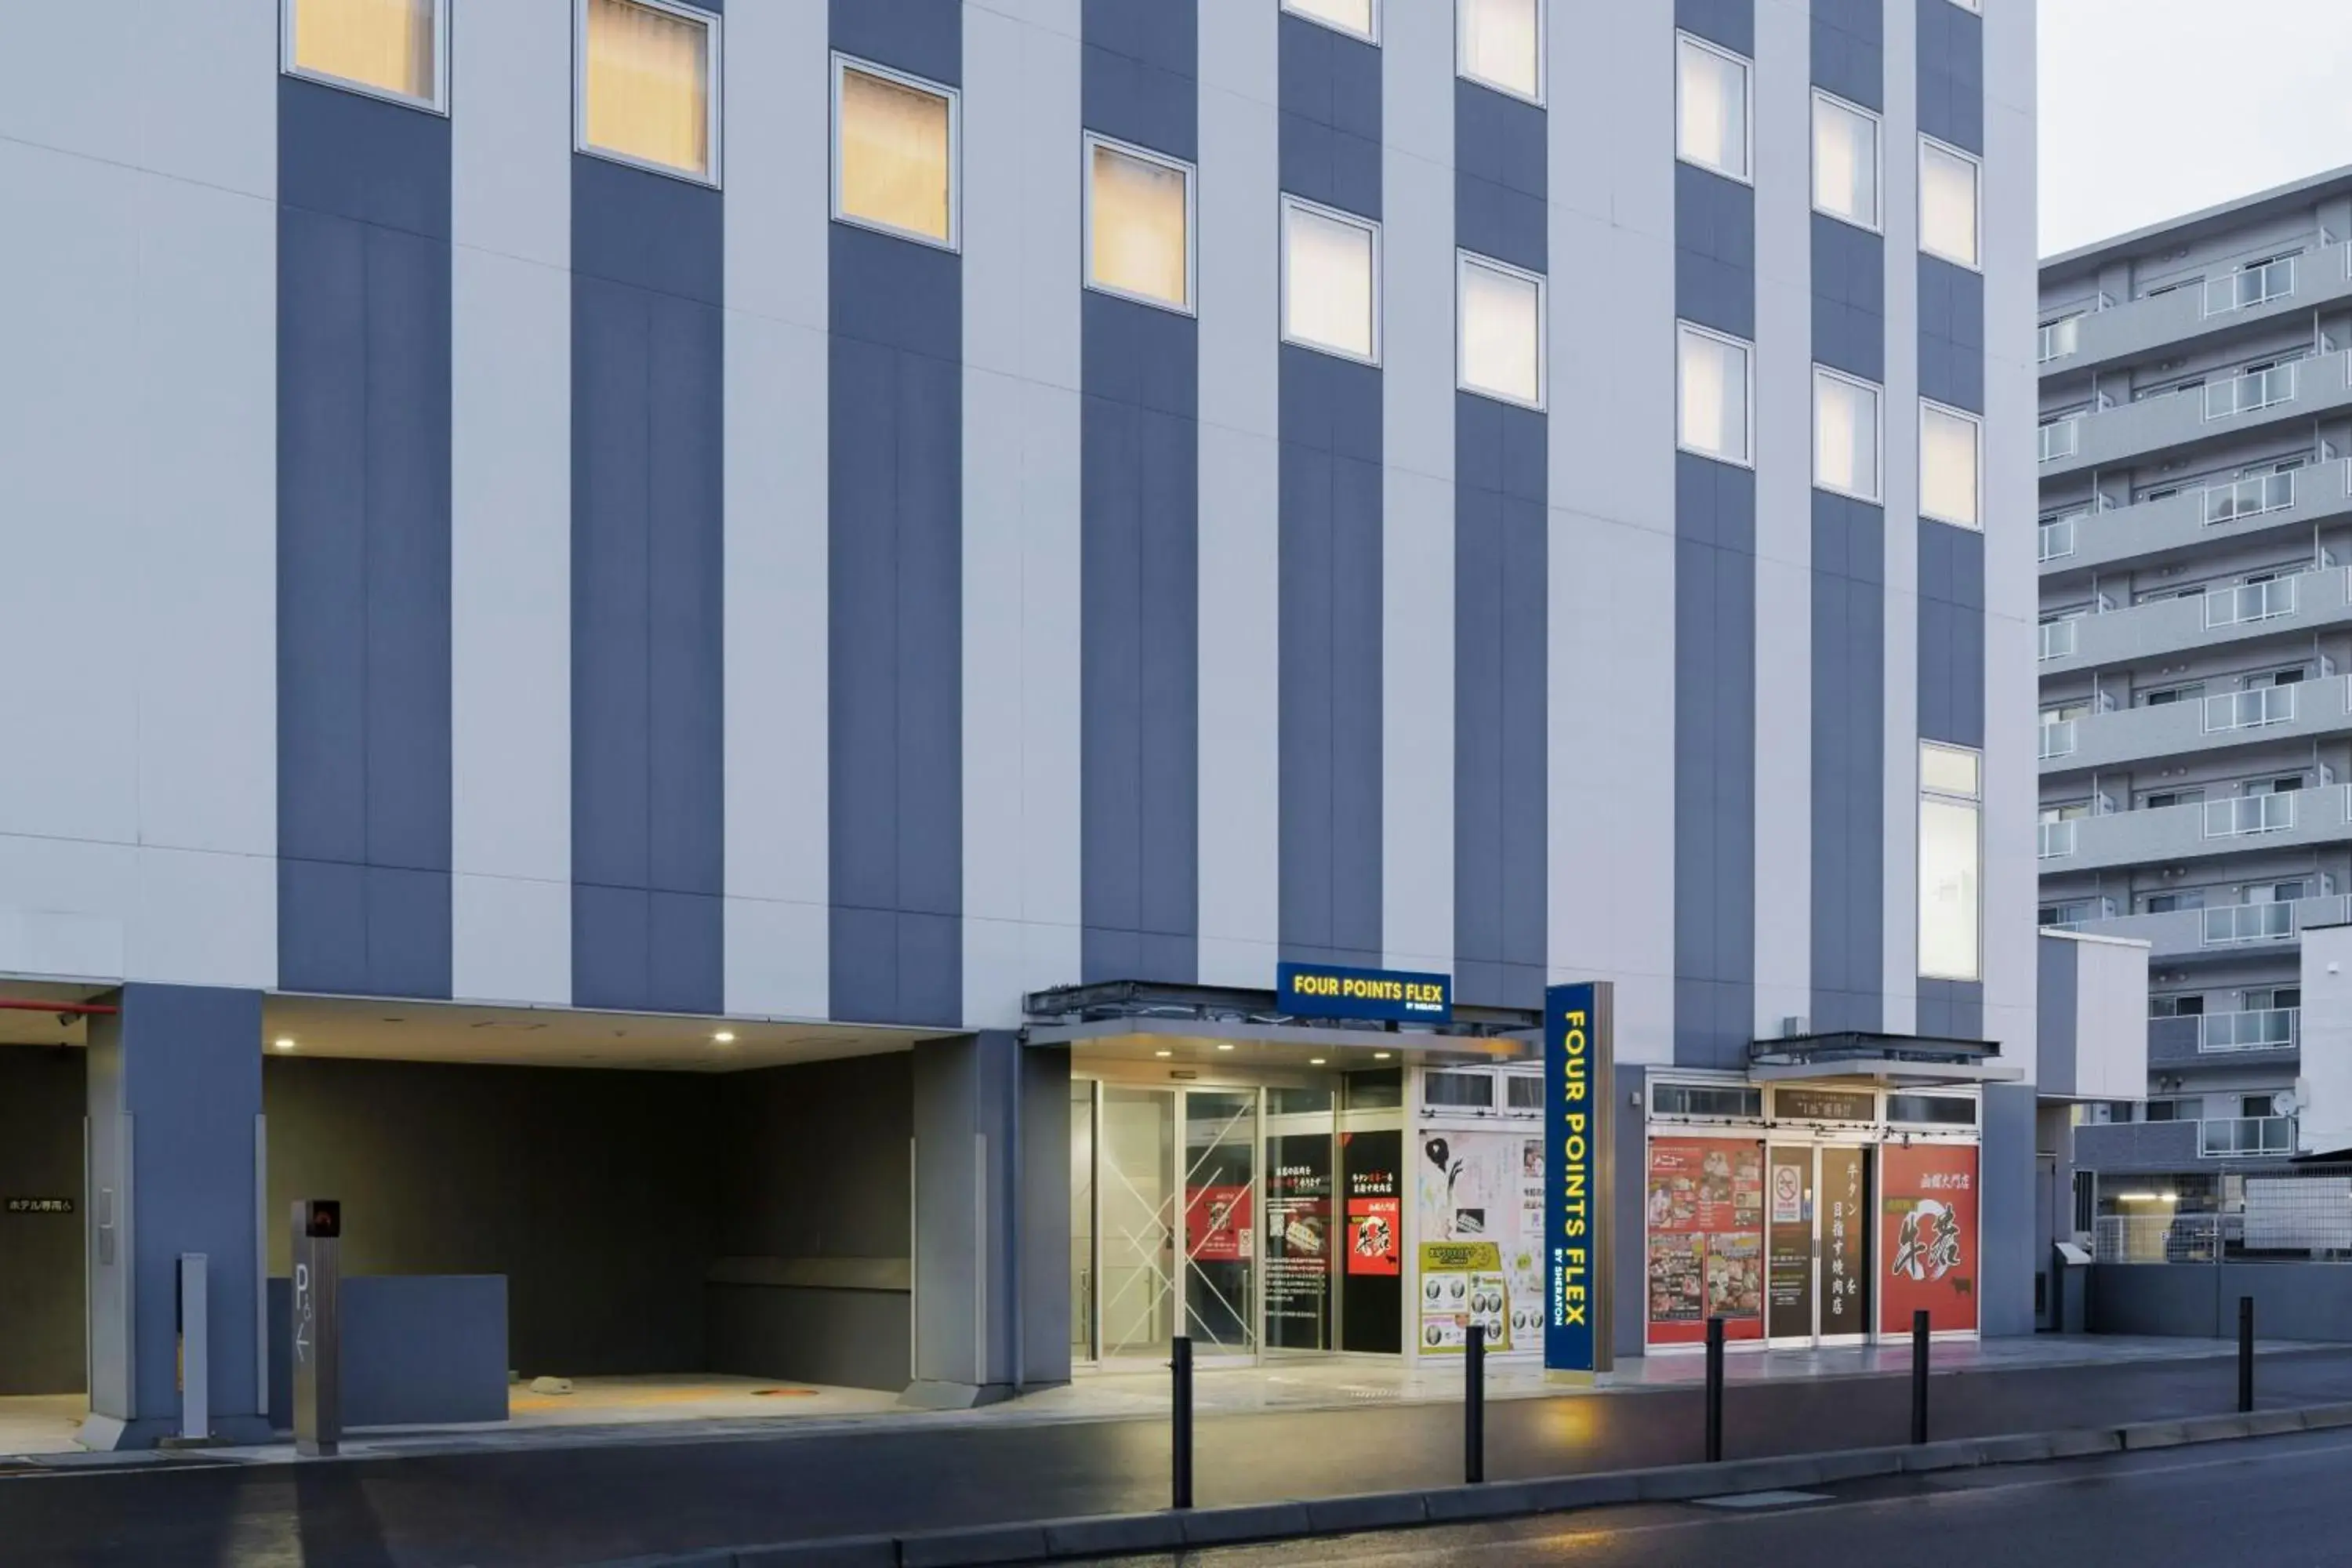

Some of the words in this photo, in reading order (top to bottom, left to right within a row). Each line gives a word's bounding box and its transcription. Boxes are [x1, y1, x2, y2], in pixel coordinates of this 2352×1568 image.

[1294, 975, 1338, 996] FOUR
[1343, 979, 1402, 1000] POINTS
[1406, 984, 1443, 1002] FLEX
[1566, 1011, 1585, 1102] FOUR
[1566, 1113, 1585, 1236] POINTS
[296, 1263, 309, 1310] P
[1555, 1249, 1563, 1263] BY
[1566, 1248, 1585, 1326] FLEX
